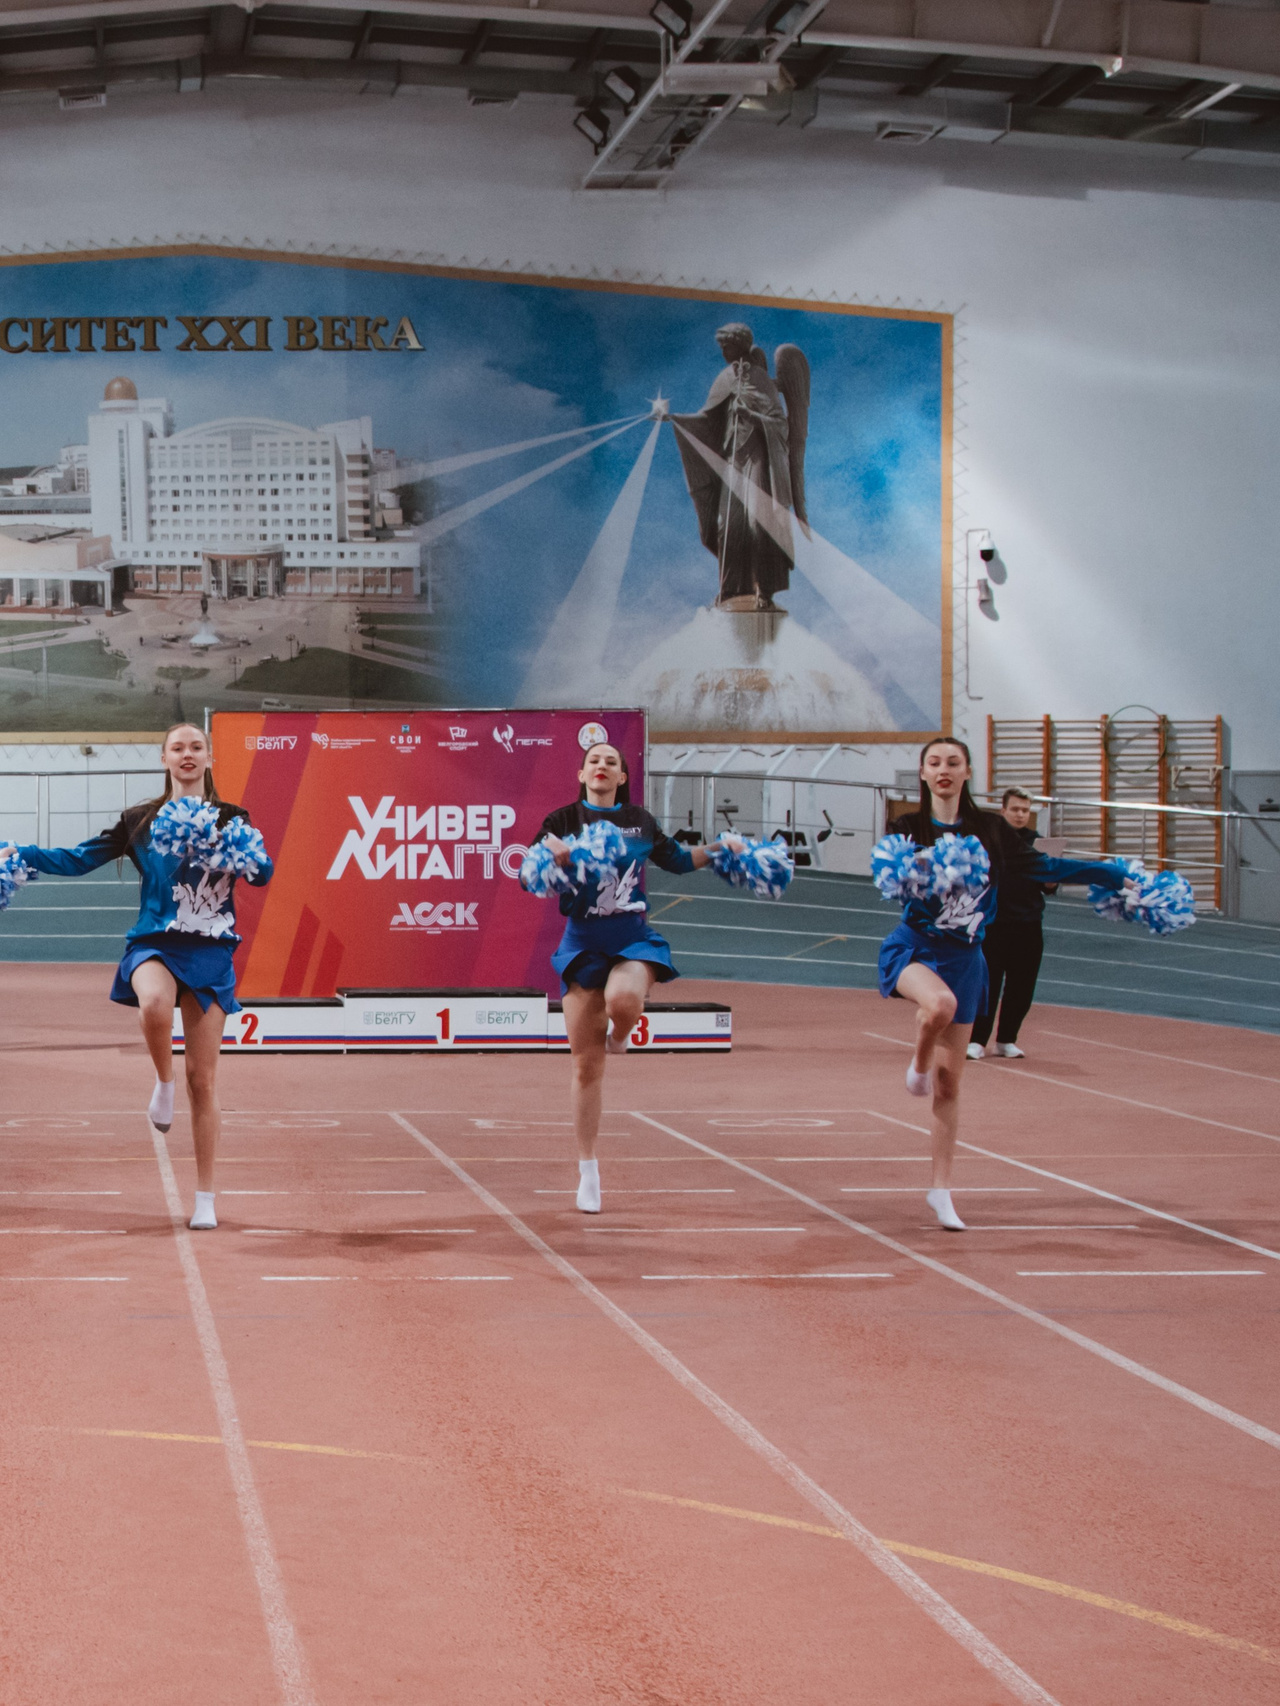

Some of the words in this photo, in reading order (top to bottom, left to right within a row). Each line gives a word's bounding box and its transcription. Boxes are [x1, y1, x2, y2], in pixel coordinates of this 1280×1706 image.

[283, 315, 426, 352] ВЕКА
[257, 737, 297, 750] БелГУ
[516, 738, 553, 746] ПЕГАС
[347, 796, 517, 844] УНИВЕР
[390, 902, 480, 926] АССК
[240, 1013, 259, 1044] 2
[375, 1012, 416, 1025] БелГУ
[436, 1008, 450, 1040] 1
[487, 1012, 528, 1024] БелГУ
[631, 1015, 649, 1046] 3
